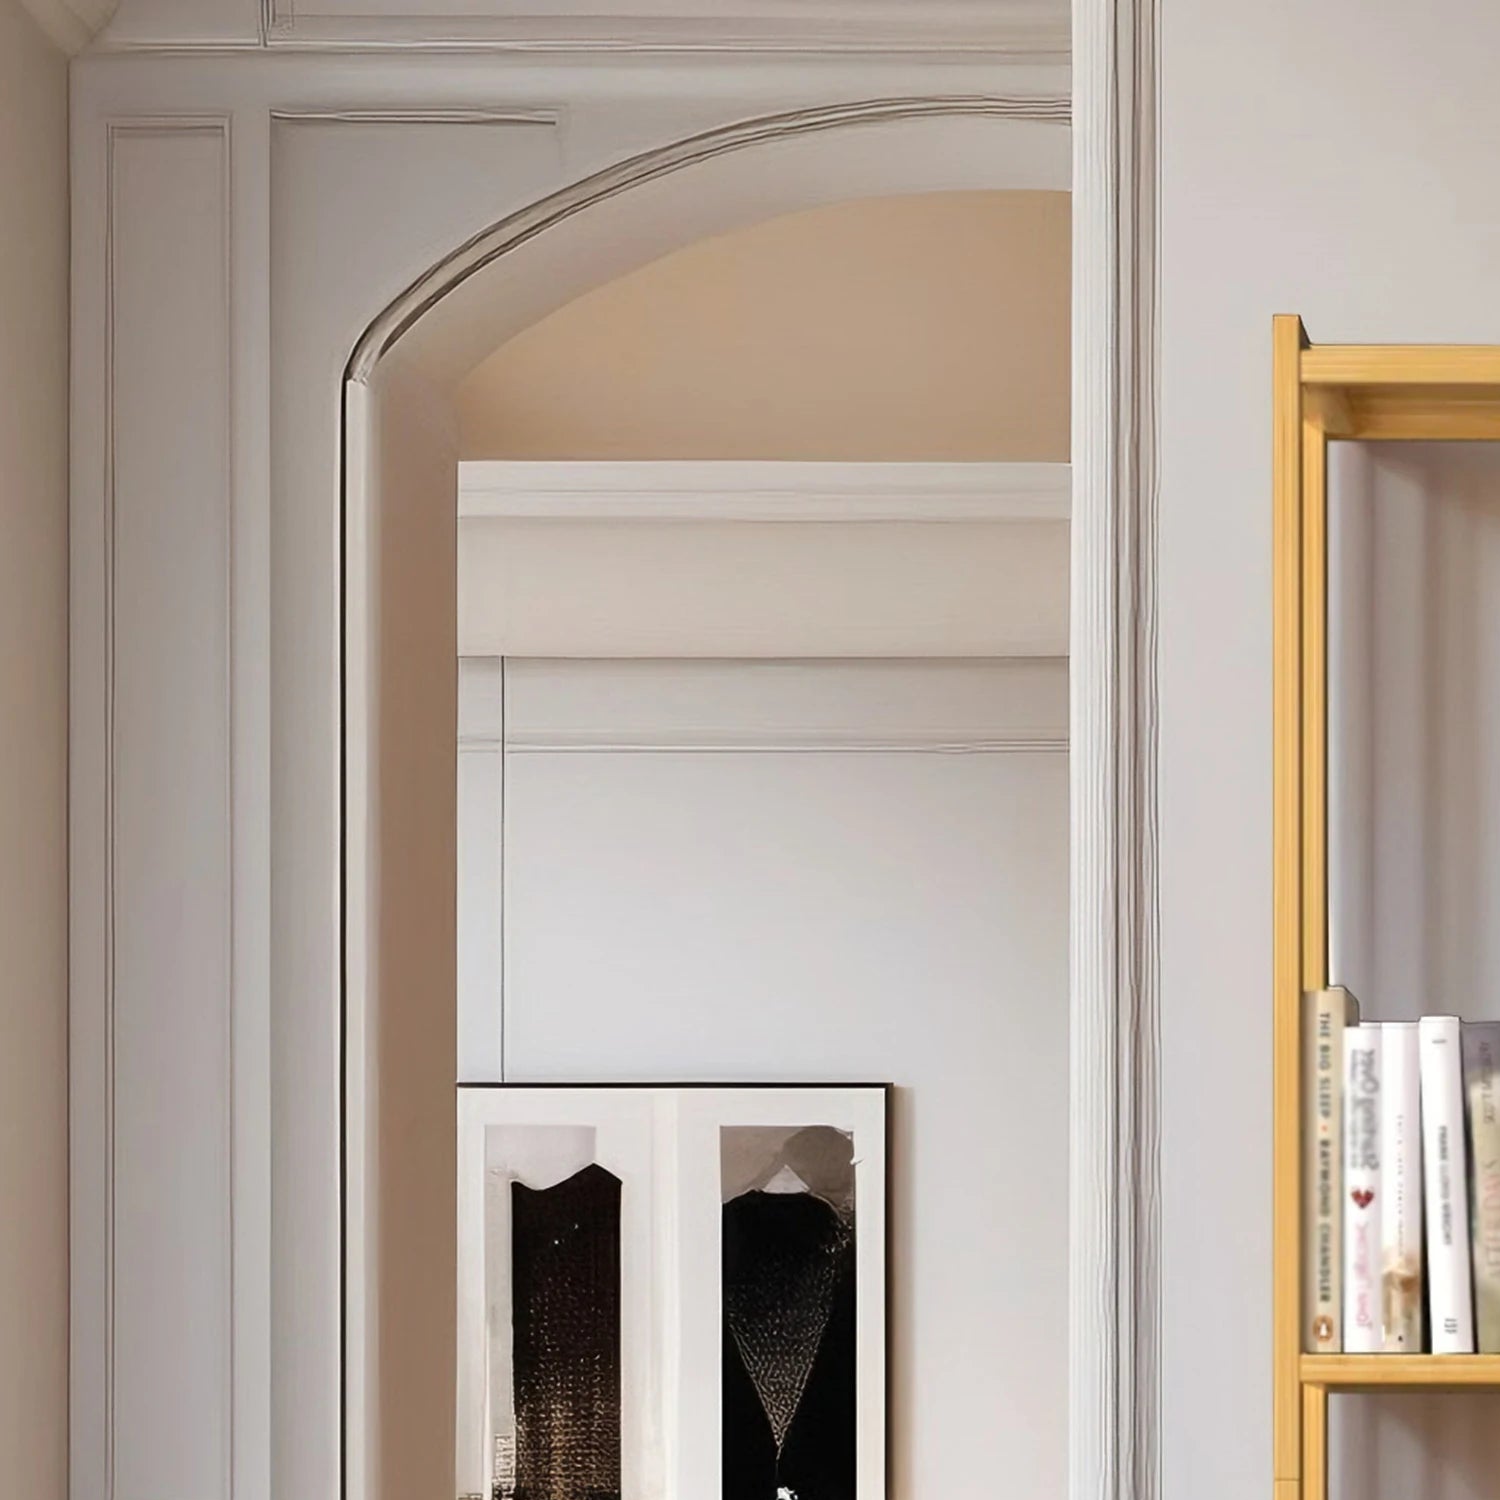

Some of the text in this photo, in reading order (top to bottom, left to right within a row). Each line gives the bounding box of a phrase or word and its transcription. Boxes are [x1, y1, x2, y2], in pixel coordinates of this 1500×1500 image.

[1318, 1012, 1332, 1303] THE BIG SLEEP RAYMOND CHANDLER
